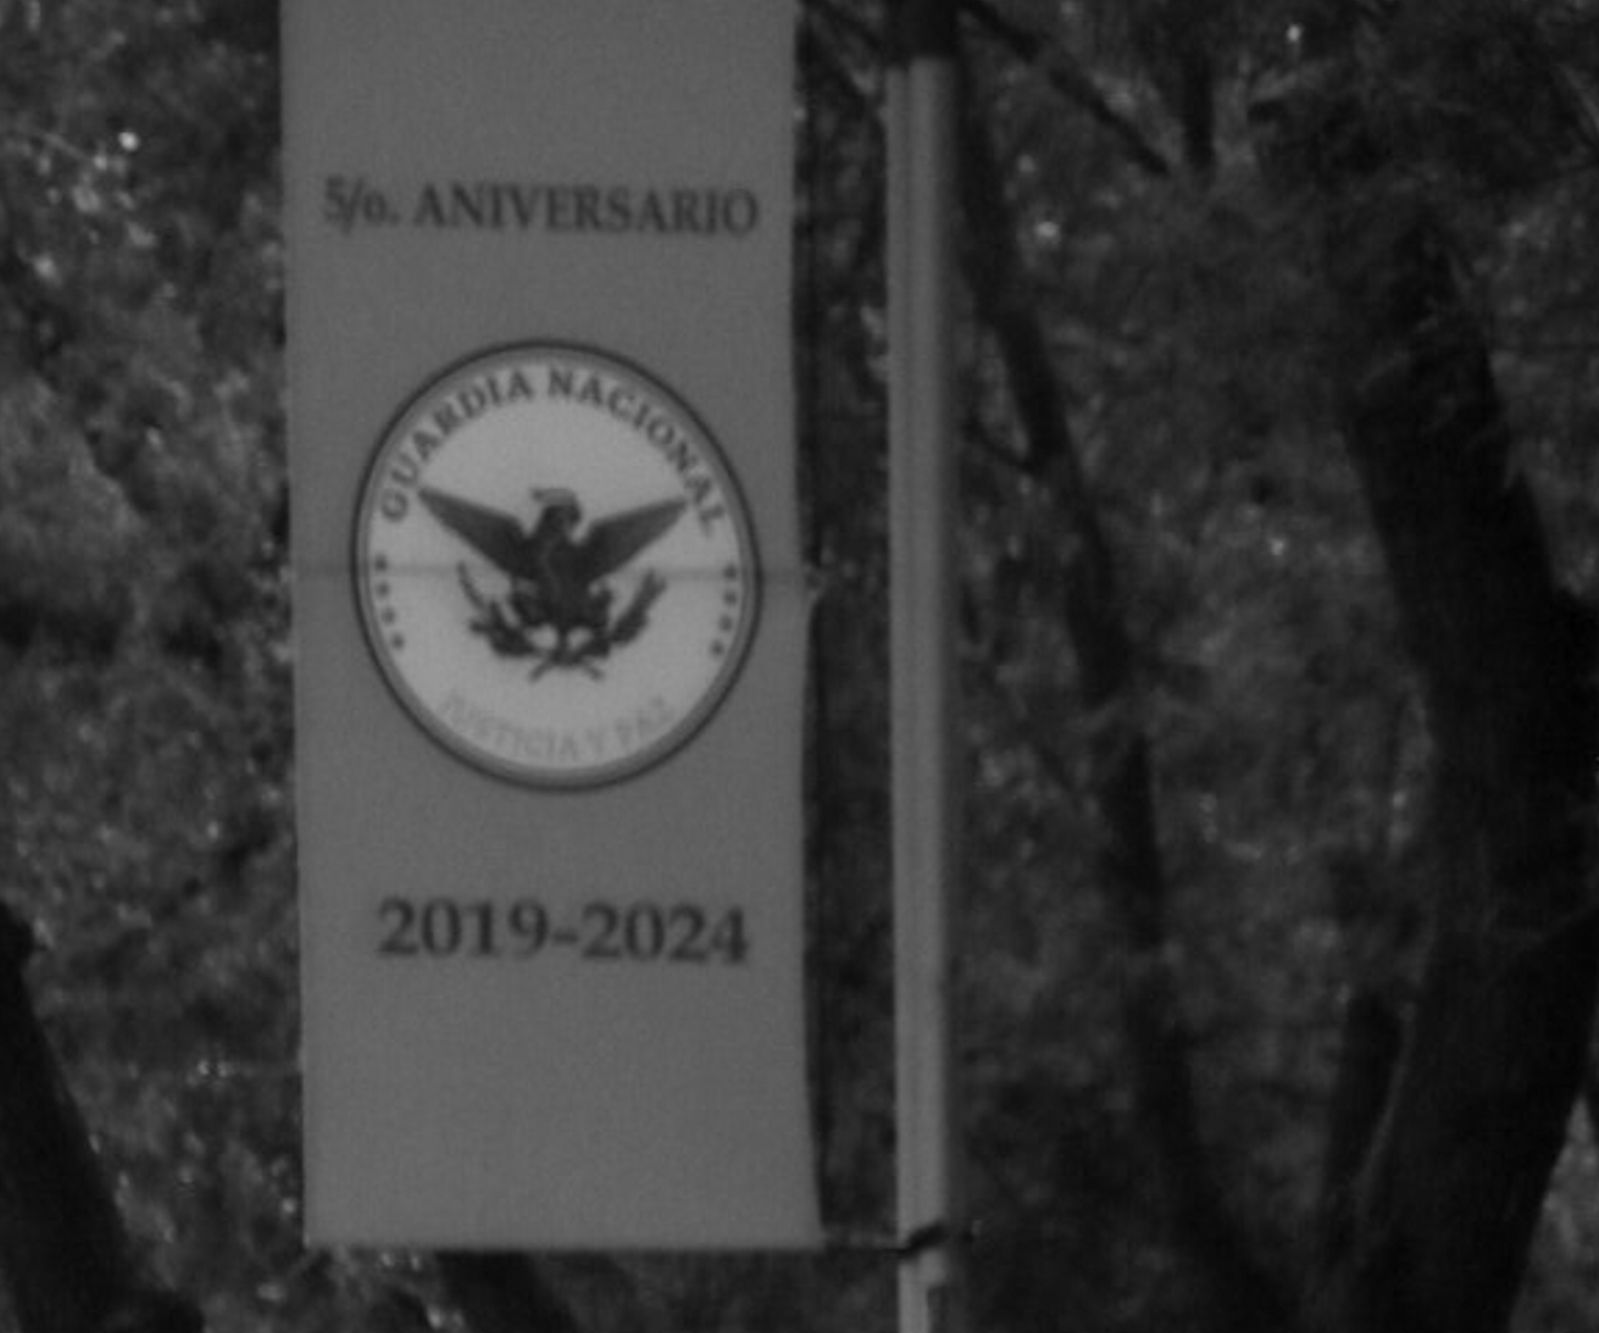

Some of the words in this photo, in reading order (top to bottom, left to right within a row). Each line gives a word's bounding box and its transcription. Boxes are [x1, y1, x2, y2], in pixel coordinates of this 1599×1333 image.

[413, 182, 759, 236] ANIVERSARIO
[380, 369, 534, 523] GUARDIA
[548, 367, 725, 534] NACIONAL
[376, 896, 751, 966] 2019-2024
